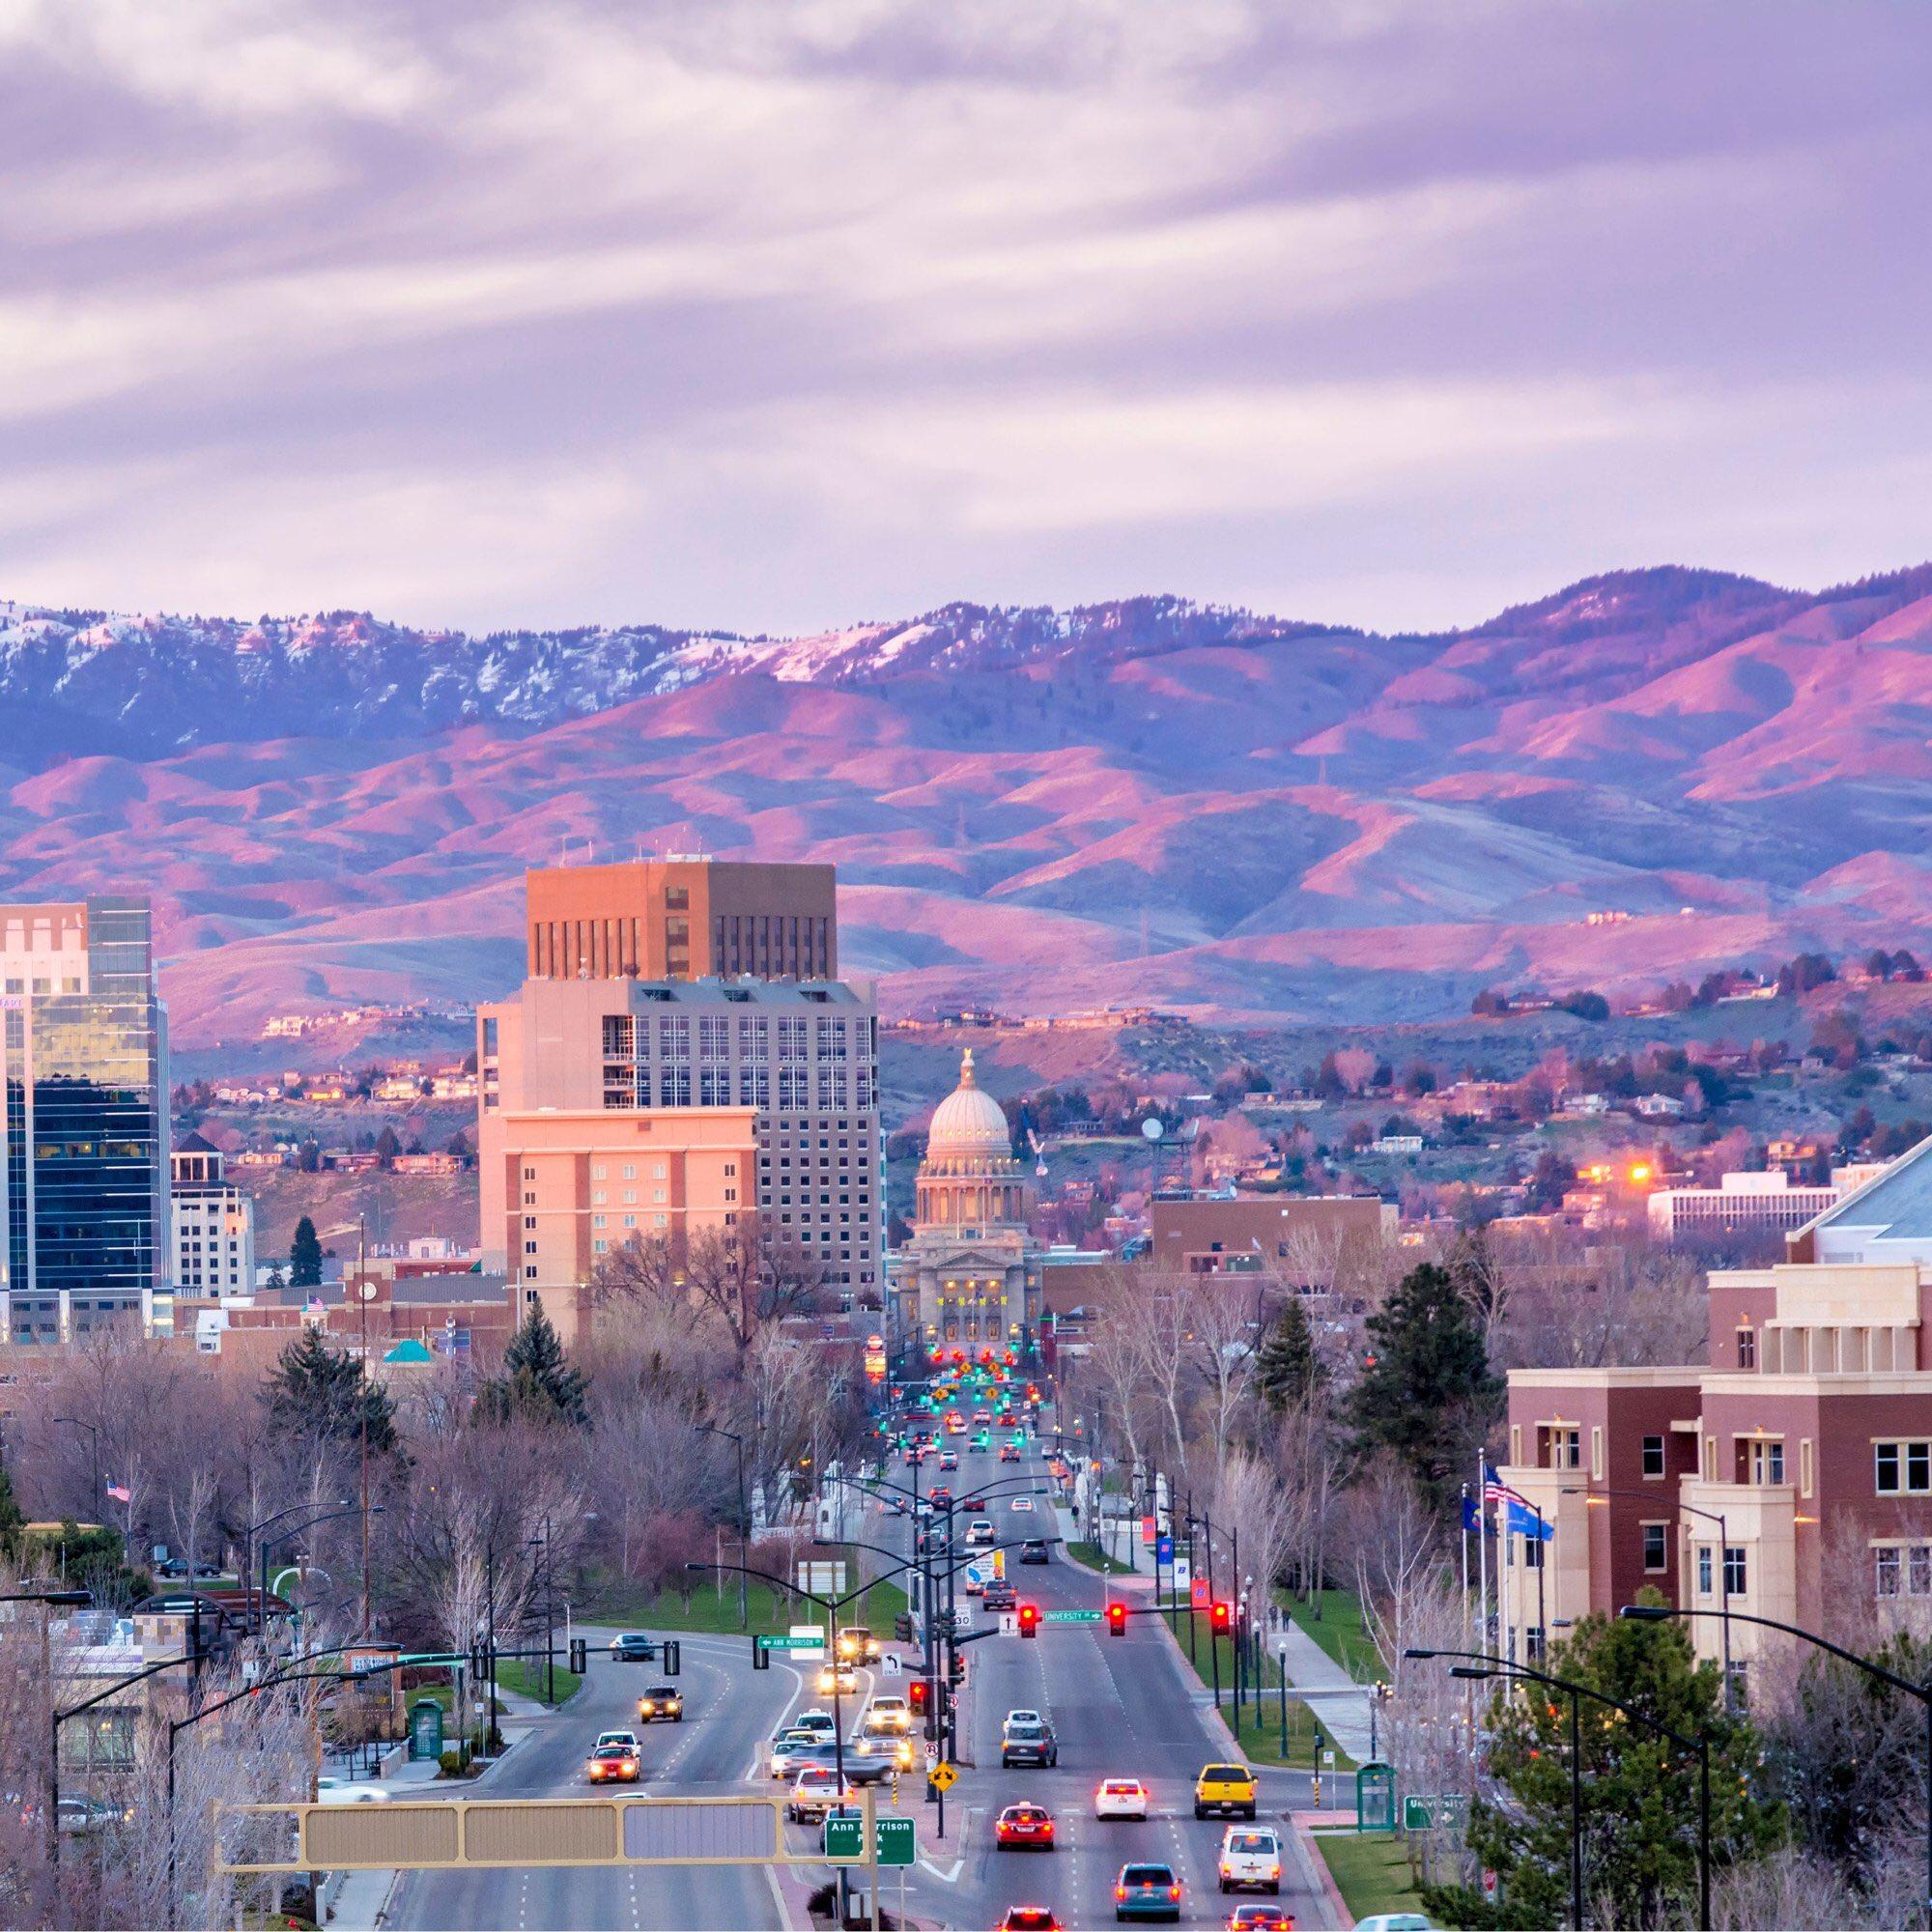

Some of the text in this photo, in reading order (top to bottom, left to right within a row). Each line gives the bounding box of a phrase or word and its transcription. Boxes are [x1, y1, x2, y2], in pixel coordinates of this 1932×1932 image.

[1044, 1611, 1082, 1621] UNIVERSITY
[832, 1822, 910, 1832] Ann rrison
[858, 1833, 883, 1842] Pk
